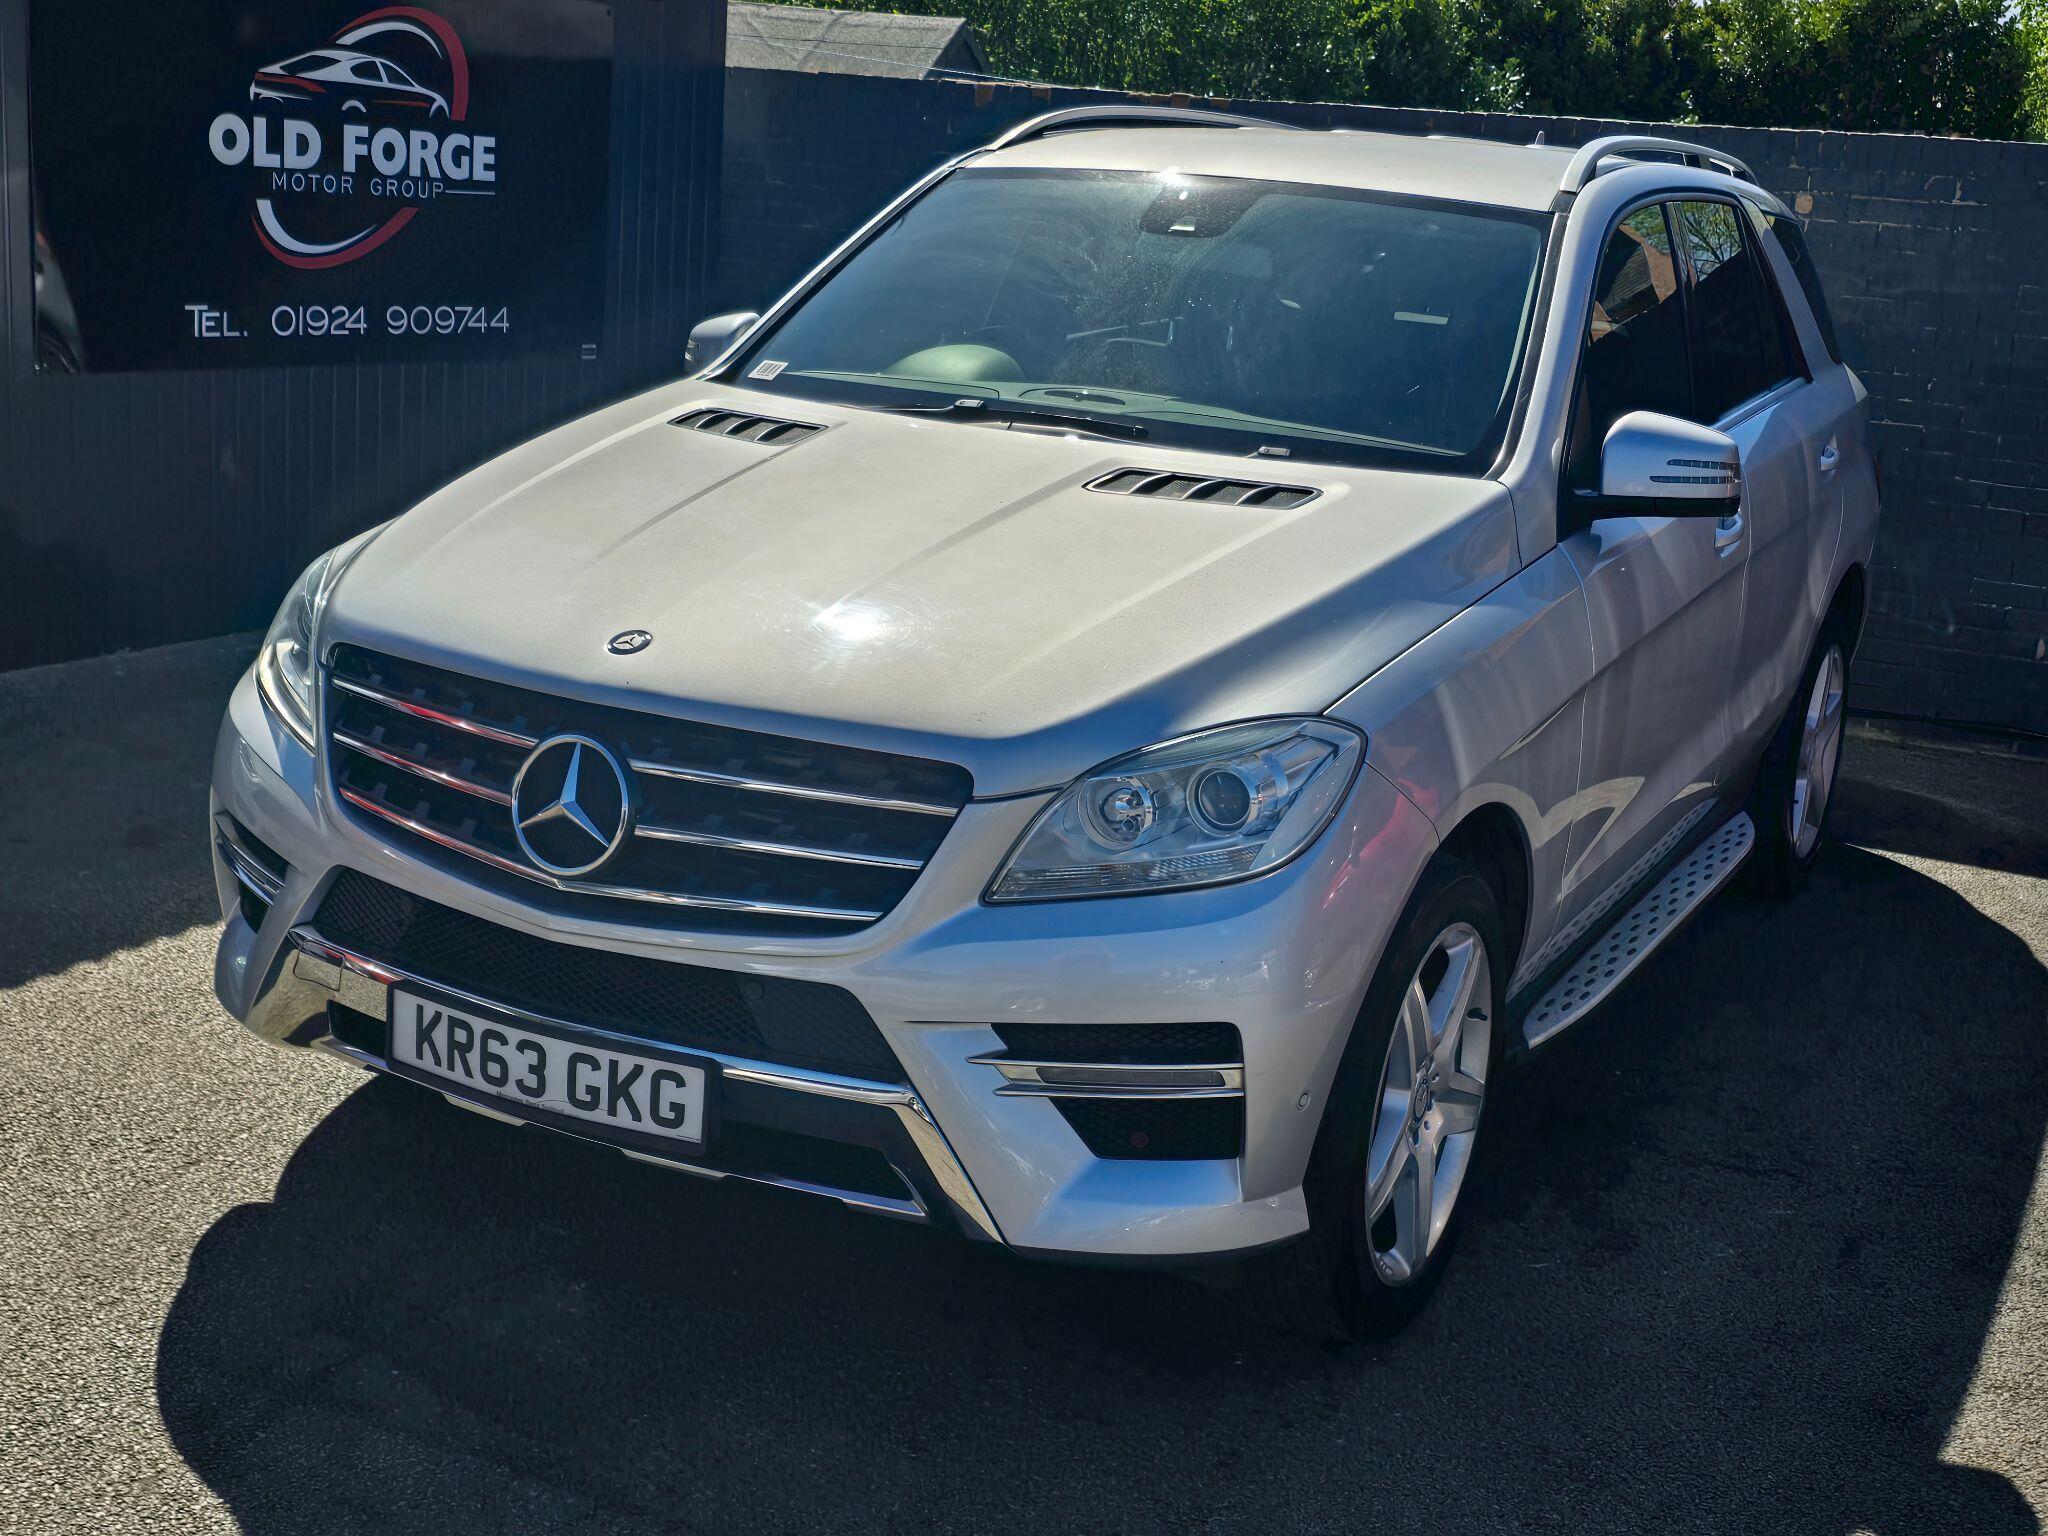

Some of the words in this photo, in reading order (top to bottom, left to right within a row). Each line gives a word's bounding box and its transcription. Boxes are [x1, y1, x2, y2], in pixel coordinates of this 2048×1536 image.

[209, 113, 322, 169] OLD
[343, 124, 496, 182] FORGE
[272, 171, 353, 194] MOTOR
[370, 178, 444, 198] GROUP
[271, 305, 368, 337] 01924
[386, 305, 510, 335] 909744
[415, 1003, 547, 1099] KR63
[566, 1051, 687, 1130] GKG
